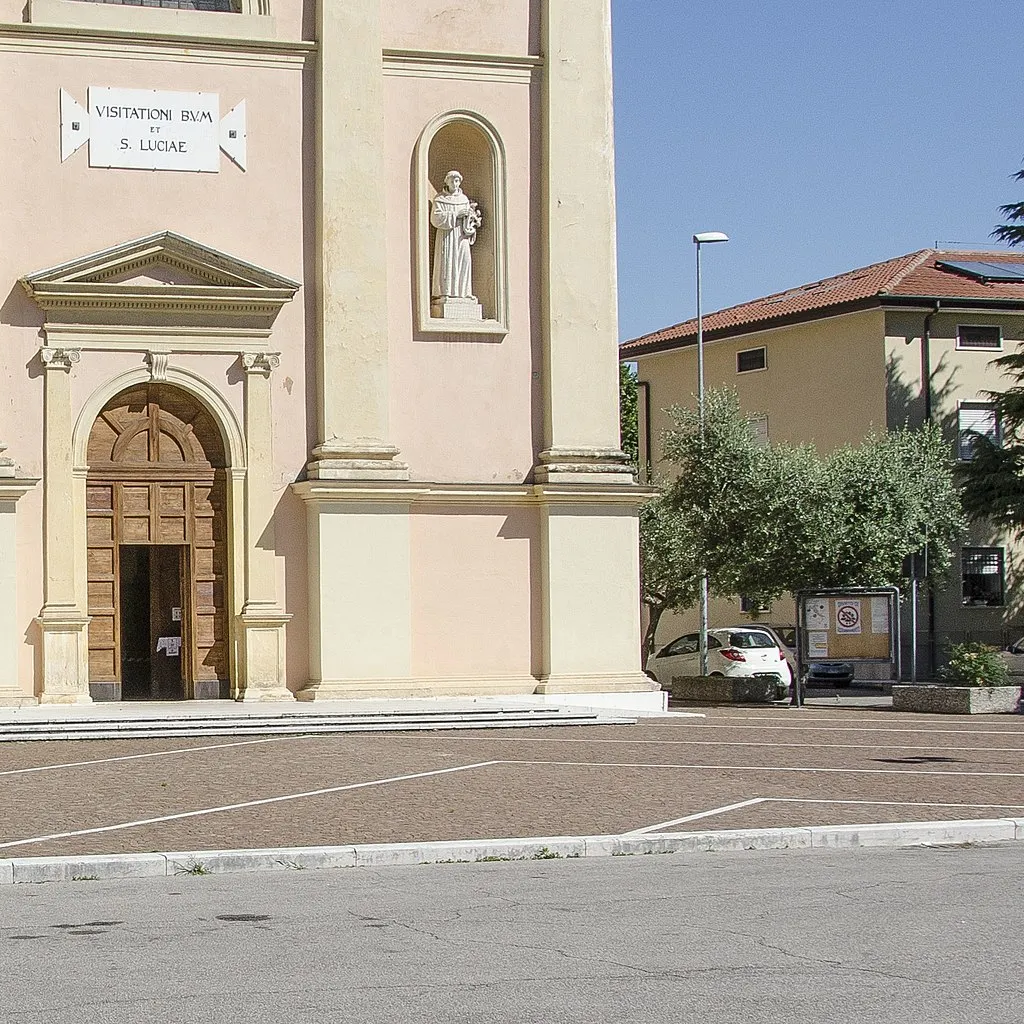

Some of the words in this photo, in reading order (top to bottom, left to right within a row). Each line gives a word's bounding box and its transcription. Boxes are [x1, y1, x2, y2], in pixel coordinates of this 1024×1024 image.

[95, 105, 172, 121] VISITATIONI
[150, 126, 161, 134] ET
[119, 138, 132, 150] S.
[140, 139, 187, 153] LUCIAE
